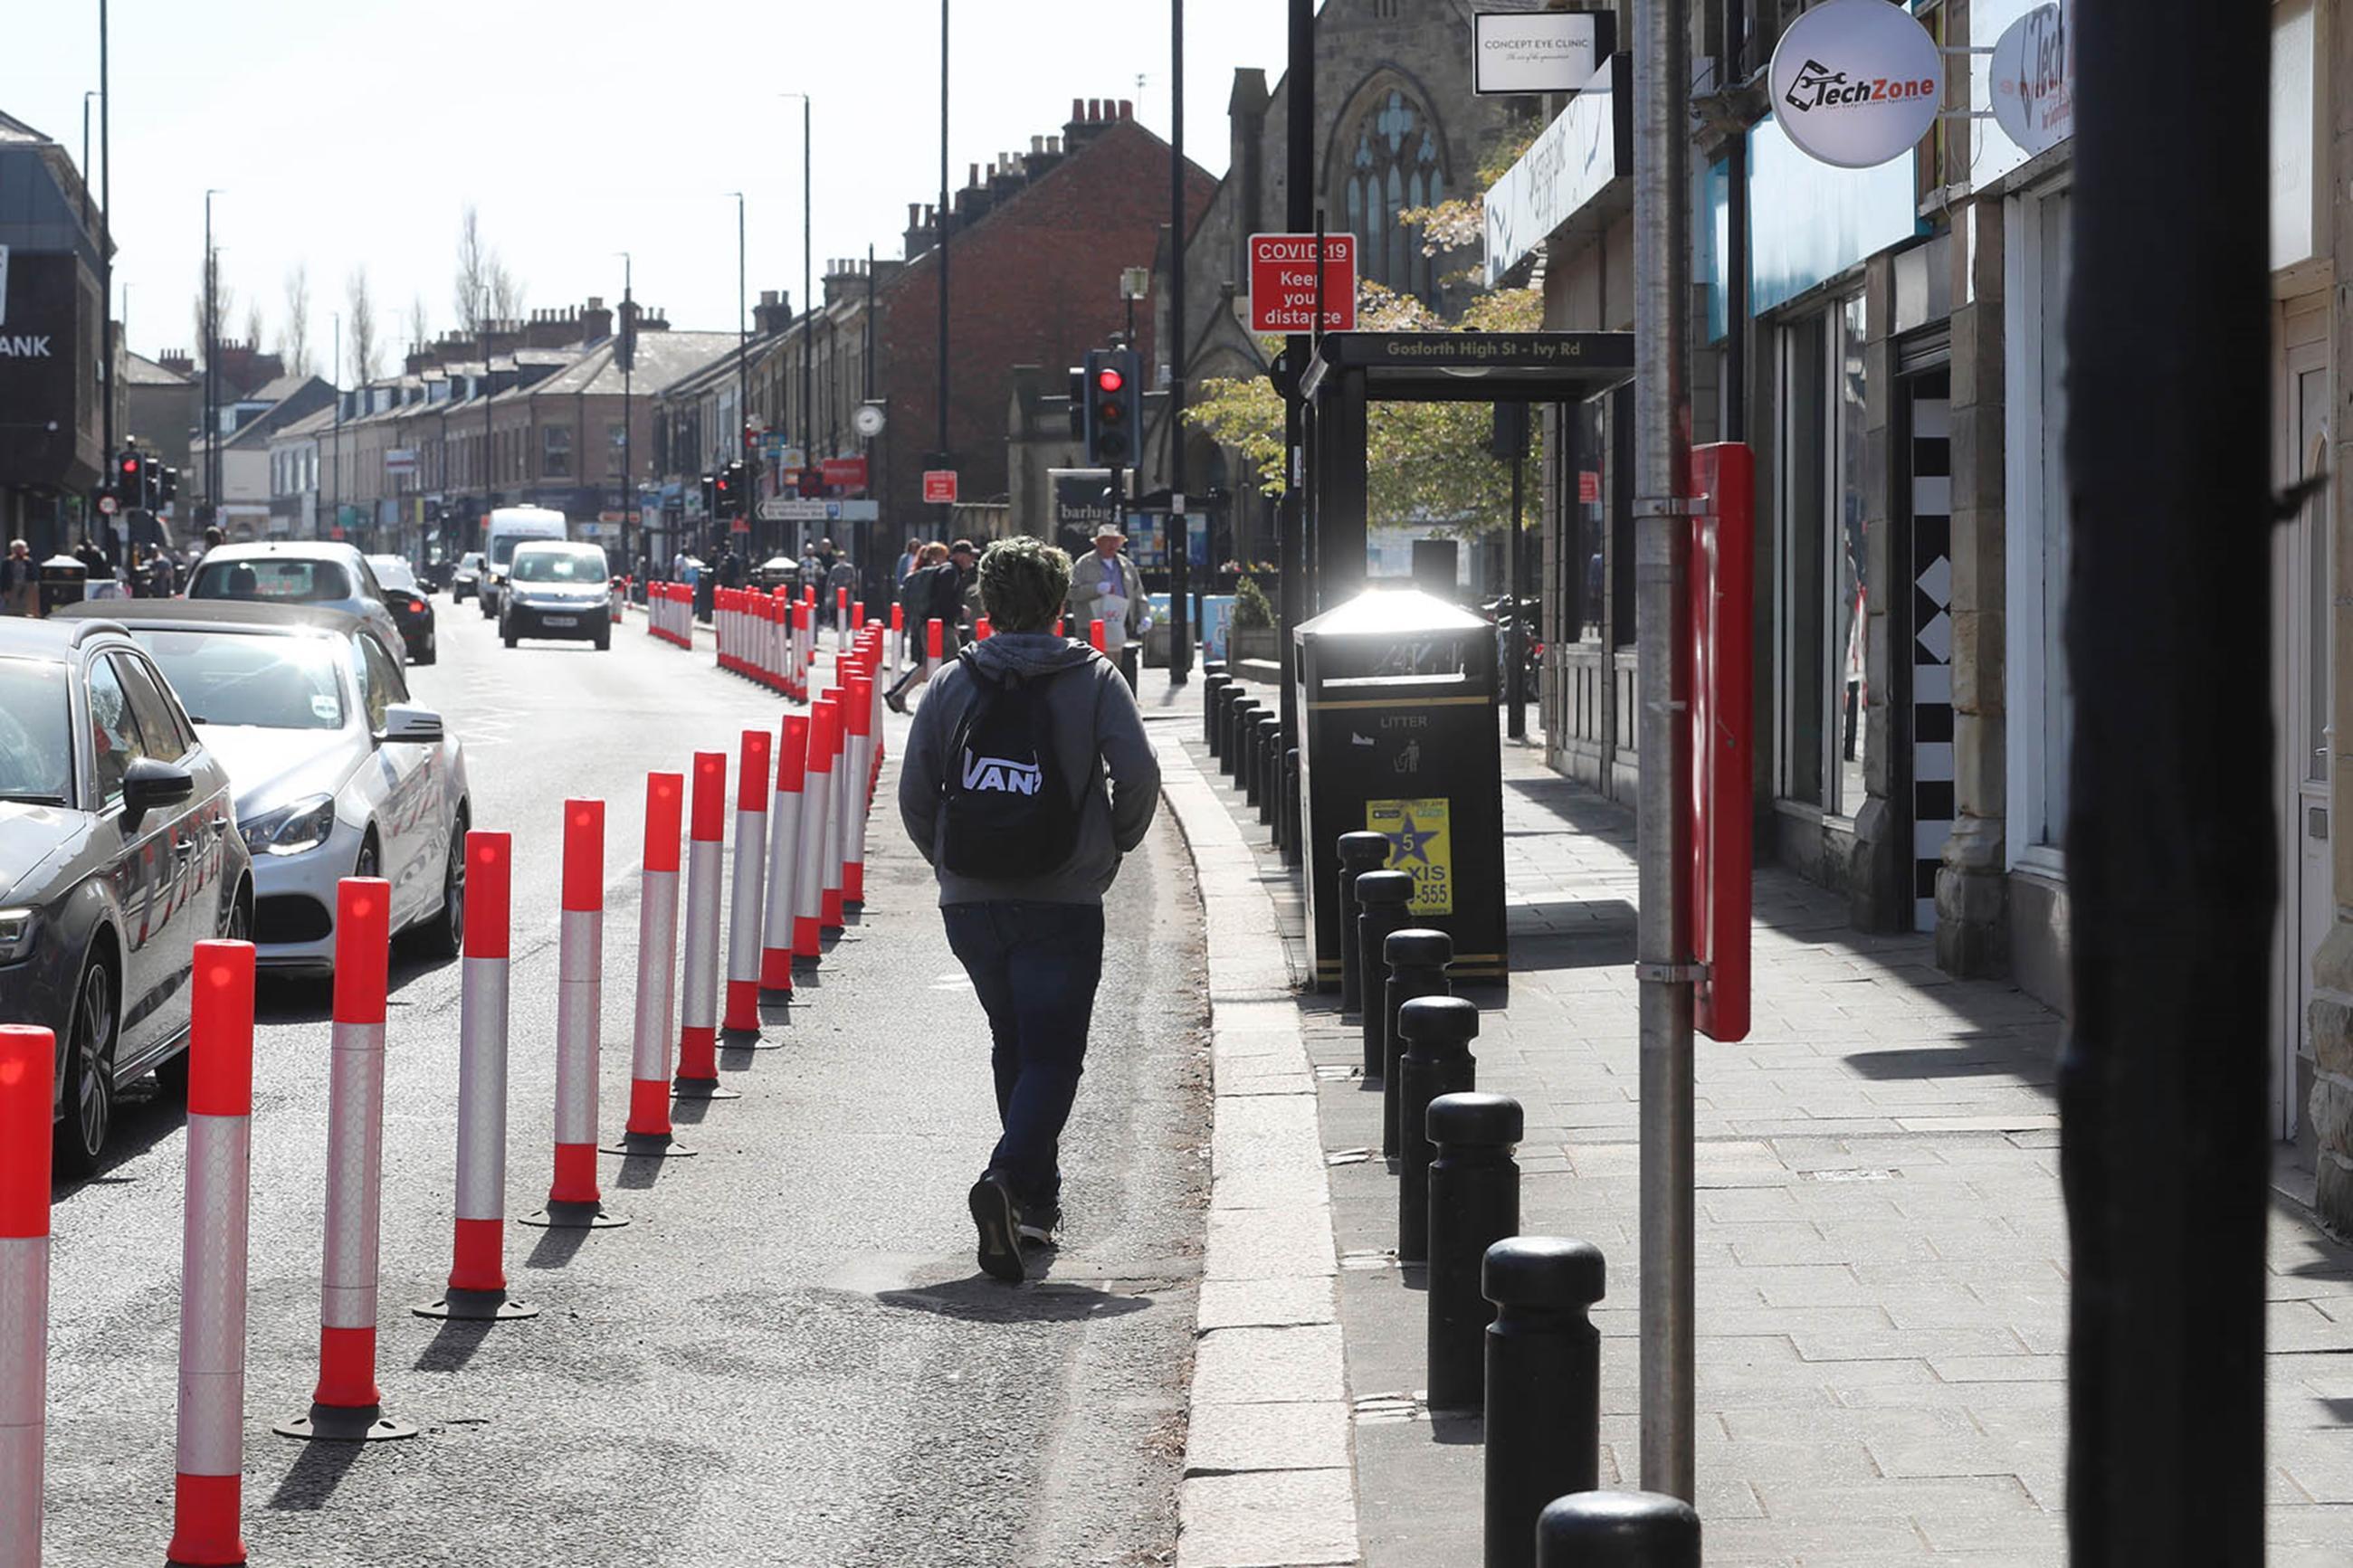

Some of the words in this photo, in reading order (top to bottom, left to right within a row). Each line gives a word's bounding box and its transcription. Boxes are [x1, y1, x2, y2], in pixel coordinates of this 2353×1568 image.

[1484, 40, 1532, 50] CONCEPT
[1535, 40, 1552, 49] EYE
[1555, 39, 1589, 48] CLINIC
[1815, 79, 1935, 106] TechZone
[1259, 243, 1347, 259] COVID-19
[1284, 293, 1316, 308] you
[1265, 309, 1341, 324] distance
[1387, 341, 1455, 356] Gosforth
[1460, 341, 1497, 358] High
[1502, 342, 1517, 356] St
[1533, 342, 1556, 358] Ivy
[1561, 342, 1581, 356] Rd
[1062, 503, 1112, 522] barlug
[1380, 715, 1429, 728] LITTER
[1402, 834, 1414, 851] 5
[1405, 865, 1446, 881] XIS
[1409, 884, 1447, 904] -555
